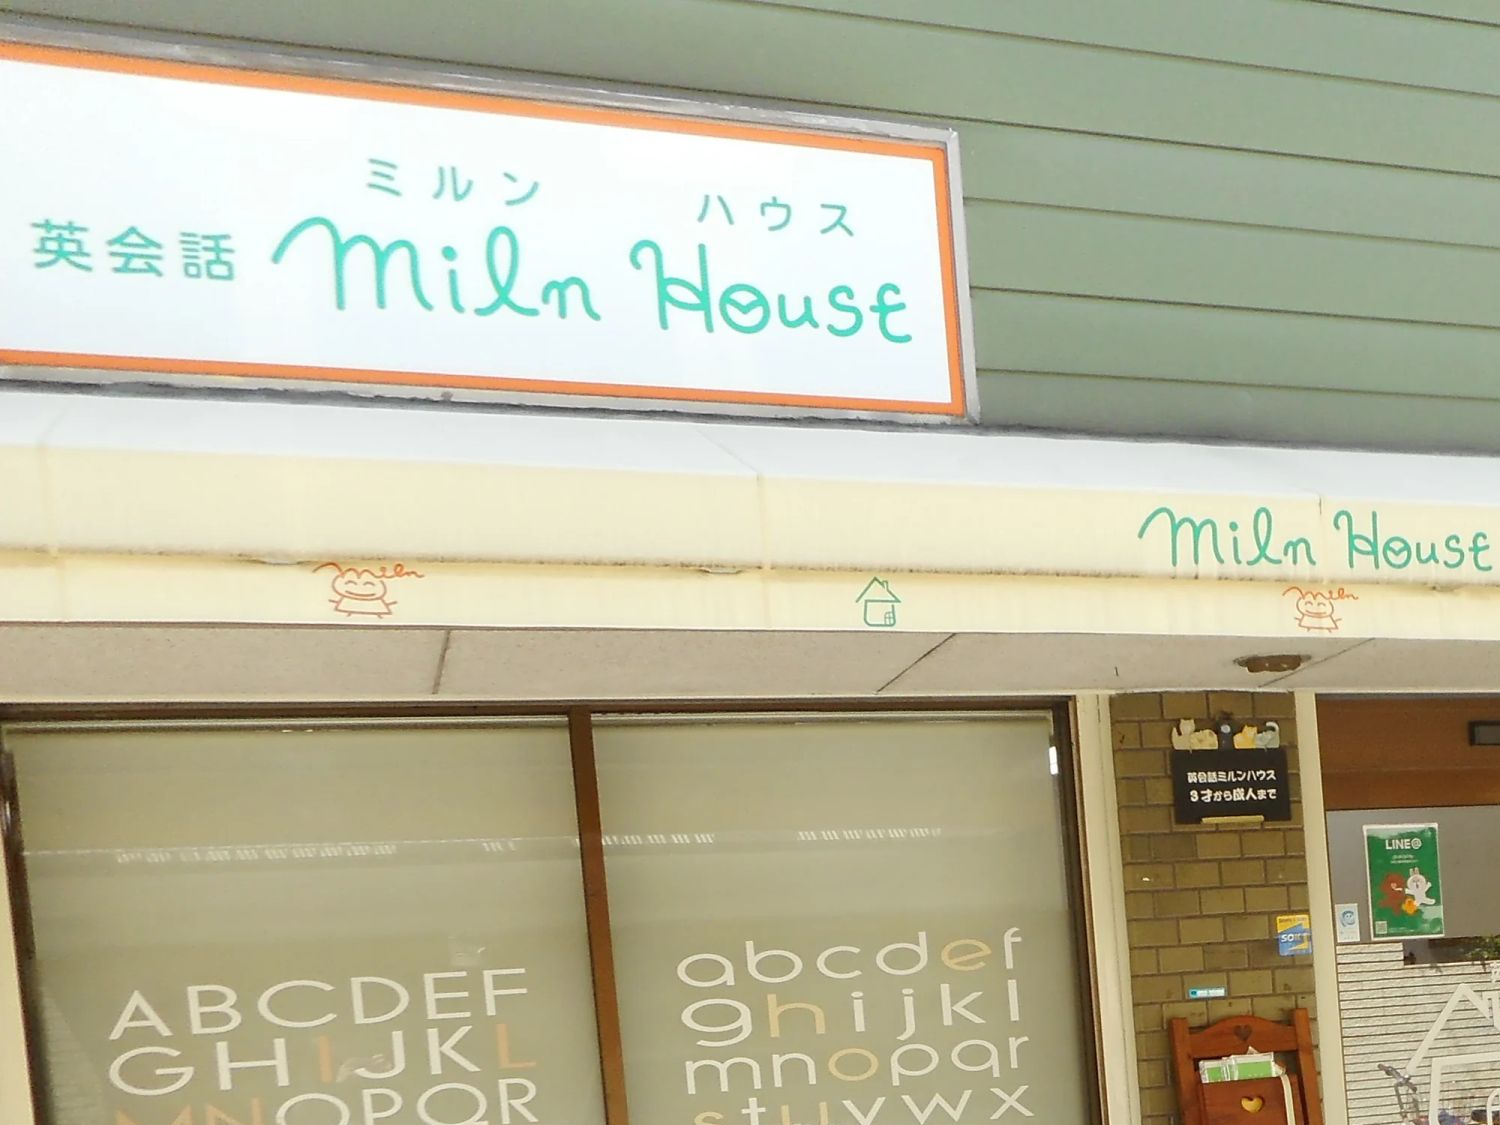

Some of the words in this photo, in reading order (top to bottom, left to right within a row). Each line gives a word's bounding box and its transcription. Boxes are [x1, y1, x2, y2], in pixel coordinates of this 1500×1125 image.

[367, 158, 539, 205] ミルン
[697, 194, 854, 237] ハウス
[31, 219, 235, 281] 英会話
[630, 240, 912, 343] House
[1333, 510, 1495, 572] House
[1187, 769, 1277, 784] 英会話ミルンハウス
[1385, 837, 1422, 850] LINE@
